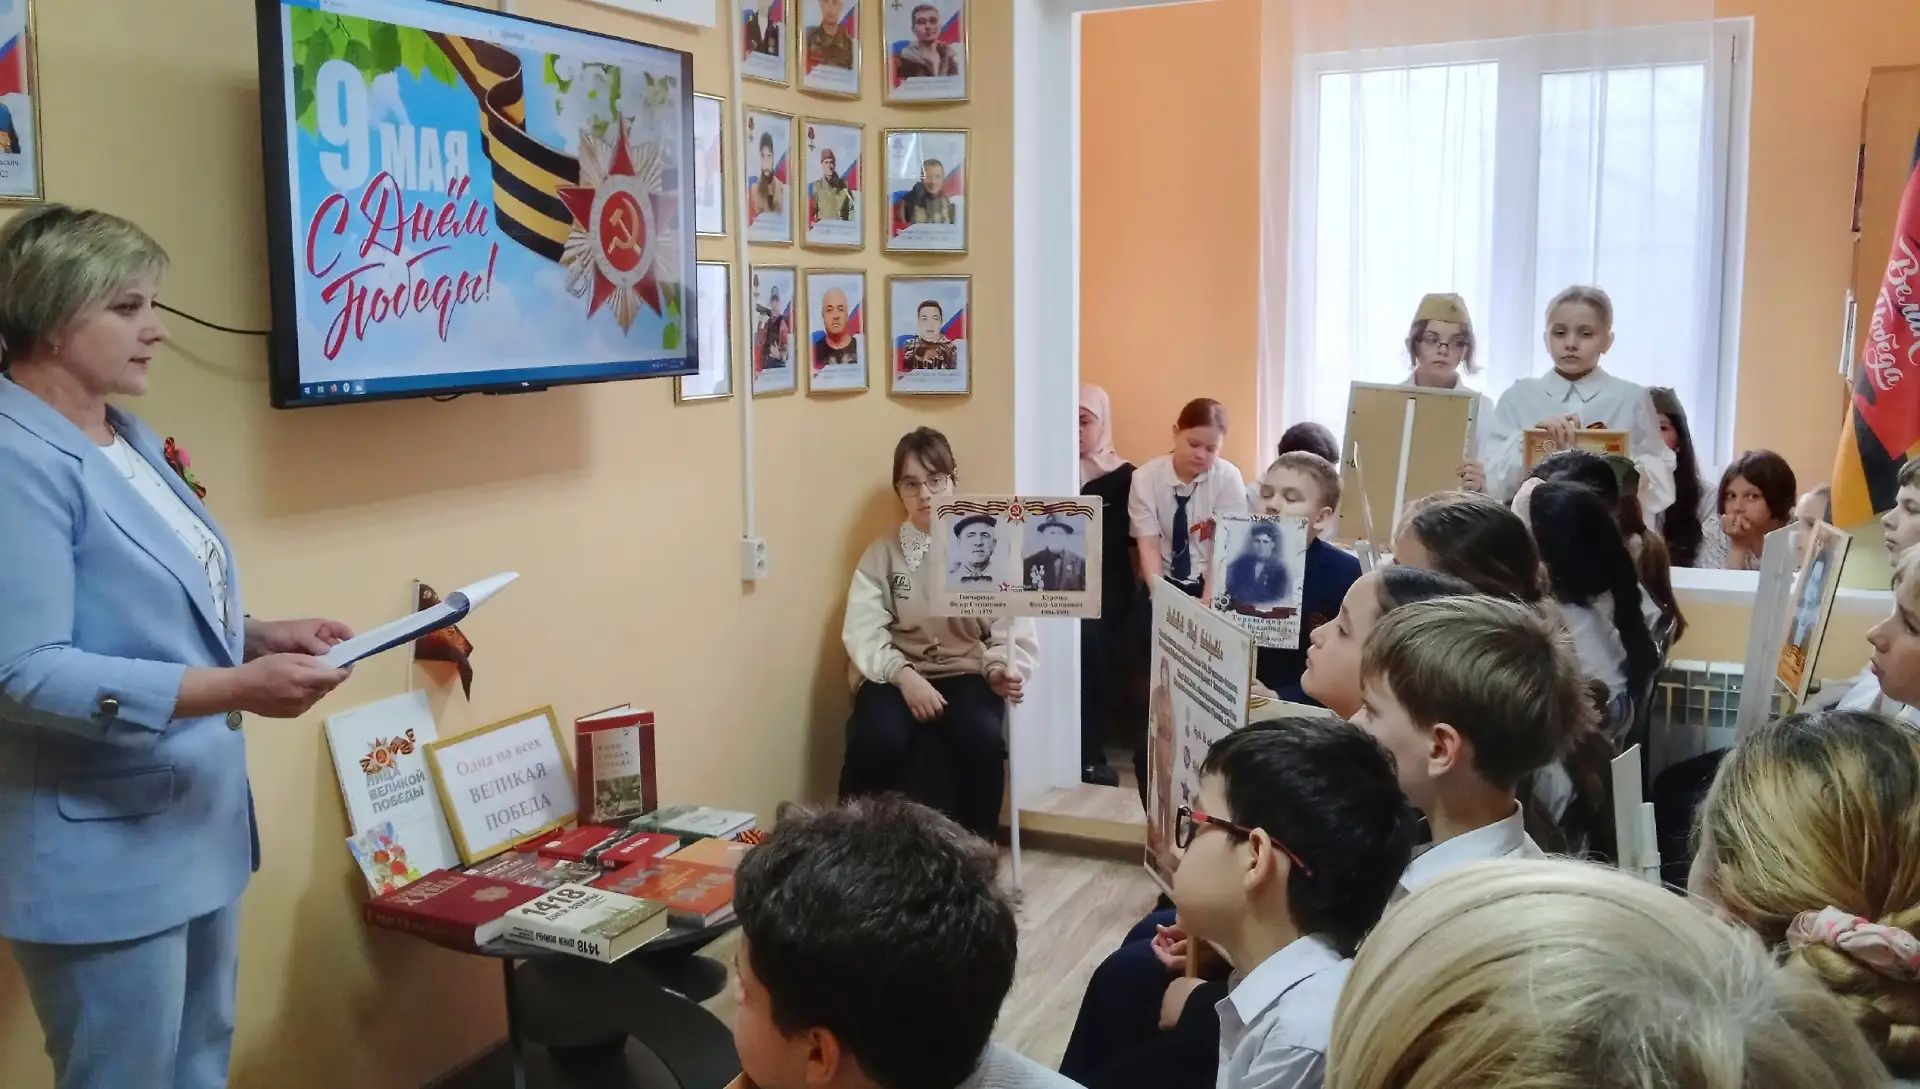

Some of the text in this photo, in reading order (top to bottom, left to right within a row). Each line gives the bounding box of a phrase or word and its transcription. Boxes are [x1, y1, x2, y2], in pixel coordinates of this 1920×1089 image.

[316, 58, 470, 194] 9 МАЯ
[306, 170, 490, 278] С Днём
[321, 240, 500, 361] Победы!
[456, 756, 494, 776] Одна
[515, 739, 542, 756] всех
[368, 768, 425, 801] ВЕЛИКОЙ
[372, 784, 425, 814] ПОБЕДЫ
[468, 762, 547, 804] ВЕЛИКАЯ
[485, 793, 552, 831] ПОБЕДА
[522, 888, 586, 916] 1418
[577, 940, 600, 957] 1418
